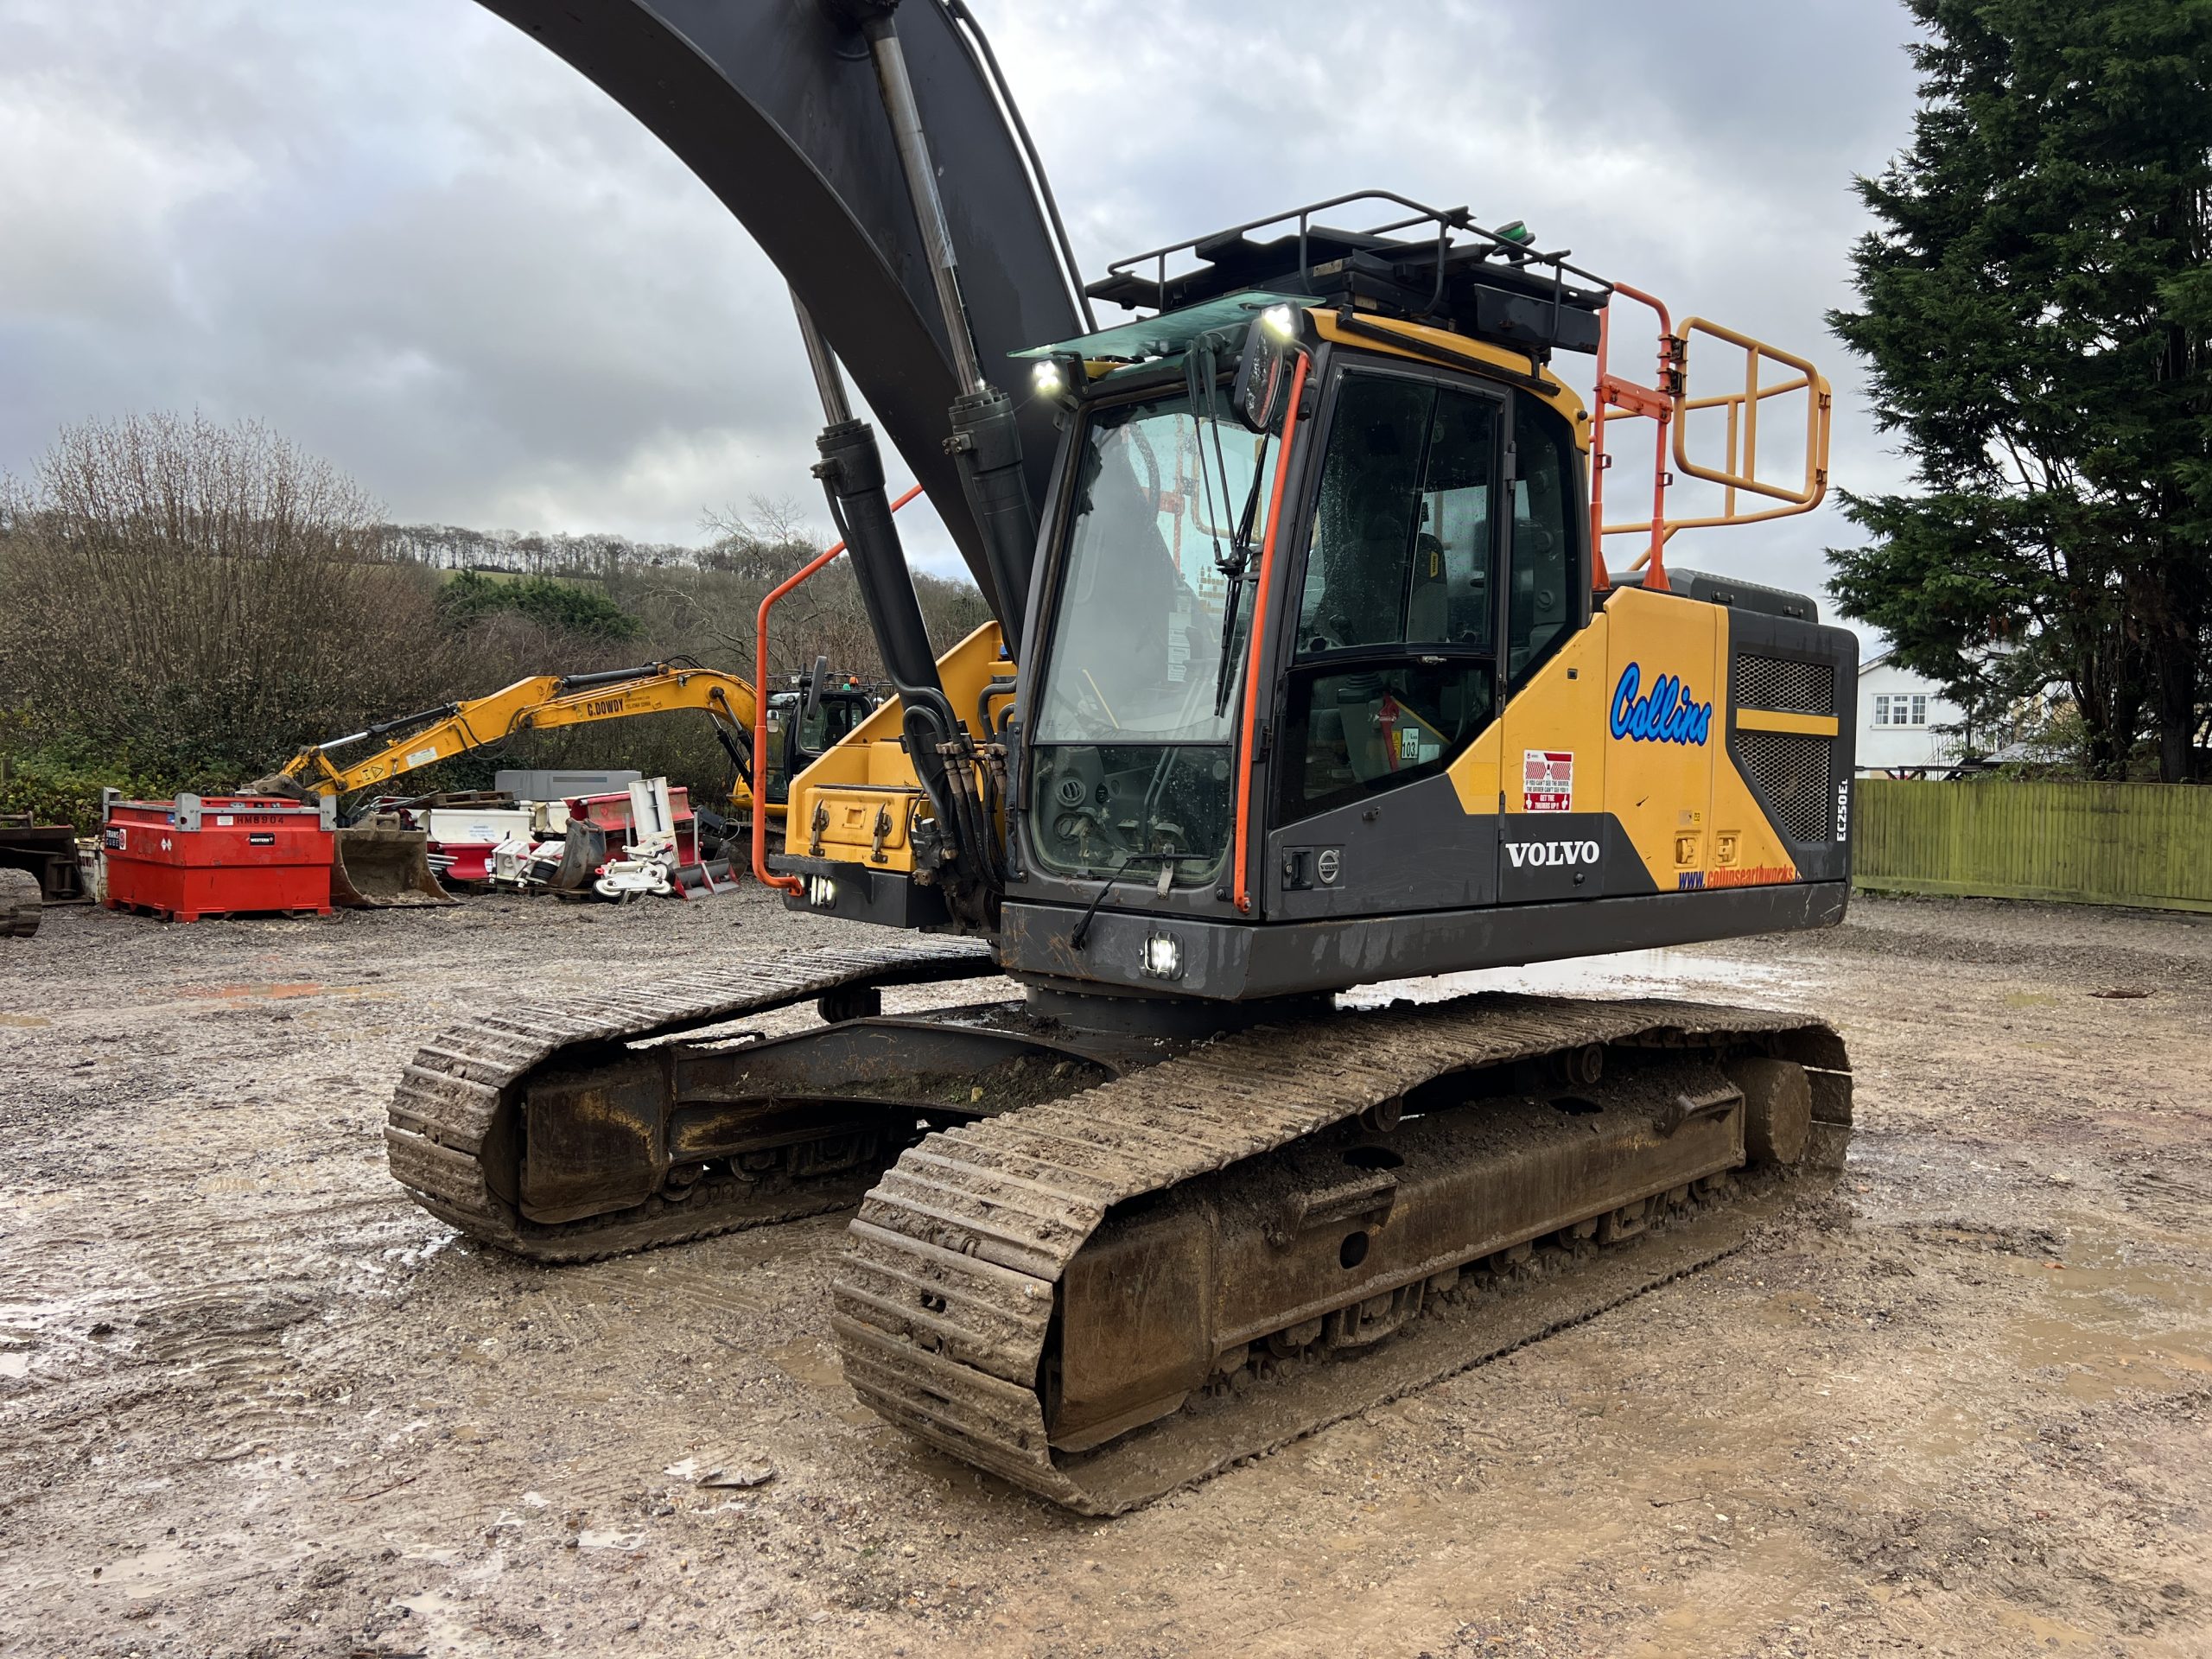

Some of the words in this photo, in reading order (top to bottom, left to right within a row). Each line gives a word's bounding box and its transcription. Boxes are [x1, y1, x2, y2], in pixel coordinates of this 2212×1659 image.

[1610, 662, 1713, 747] Collins
[1402, 742, 1415, 757] 103
[237, 816, 284, 824] HM8904
[1836, 779, 1848, 842] EC250EL
[105, 830, 119, 839] TRANS
[1505, 841, 1600, 867] VOLVO
